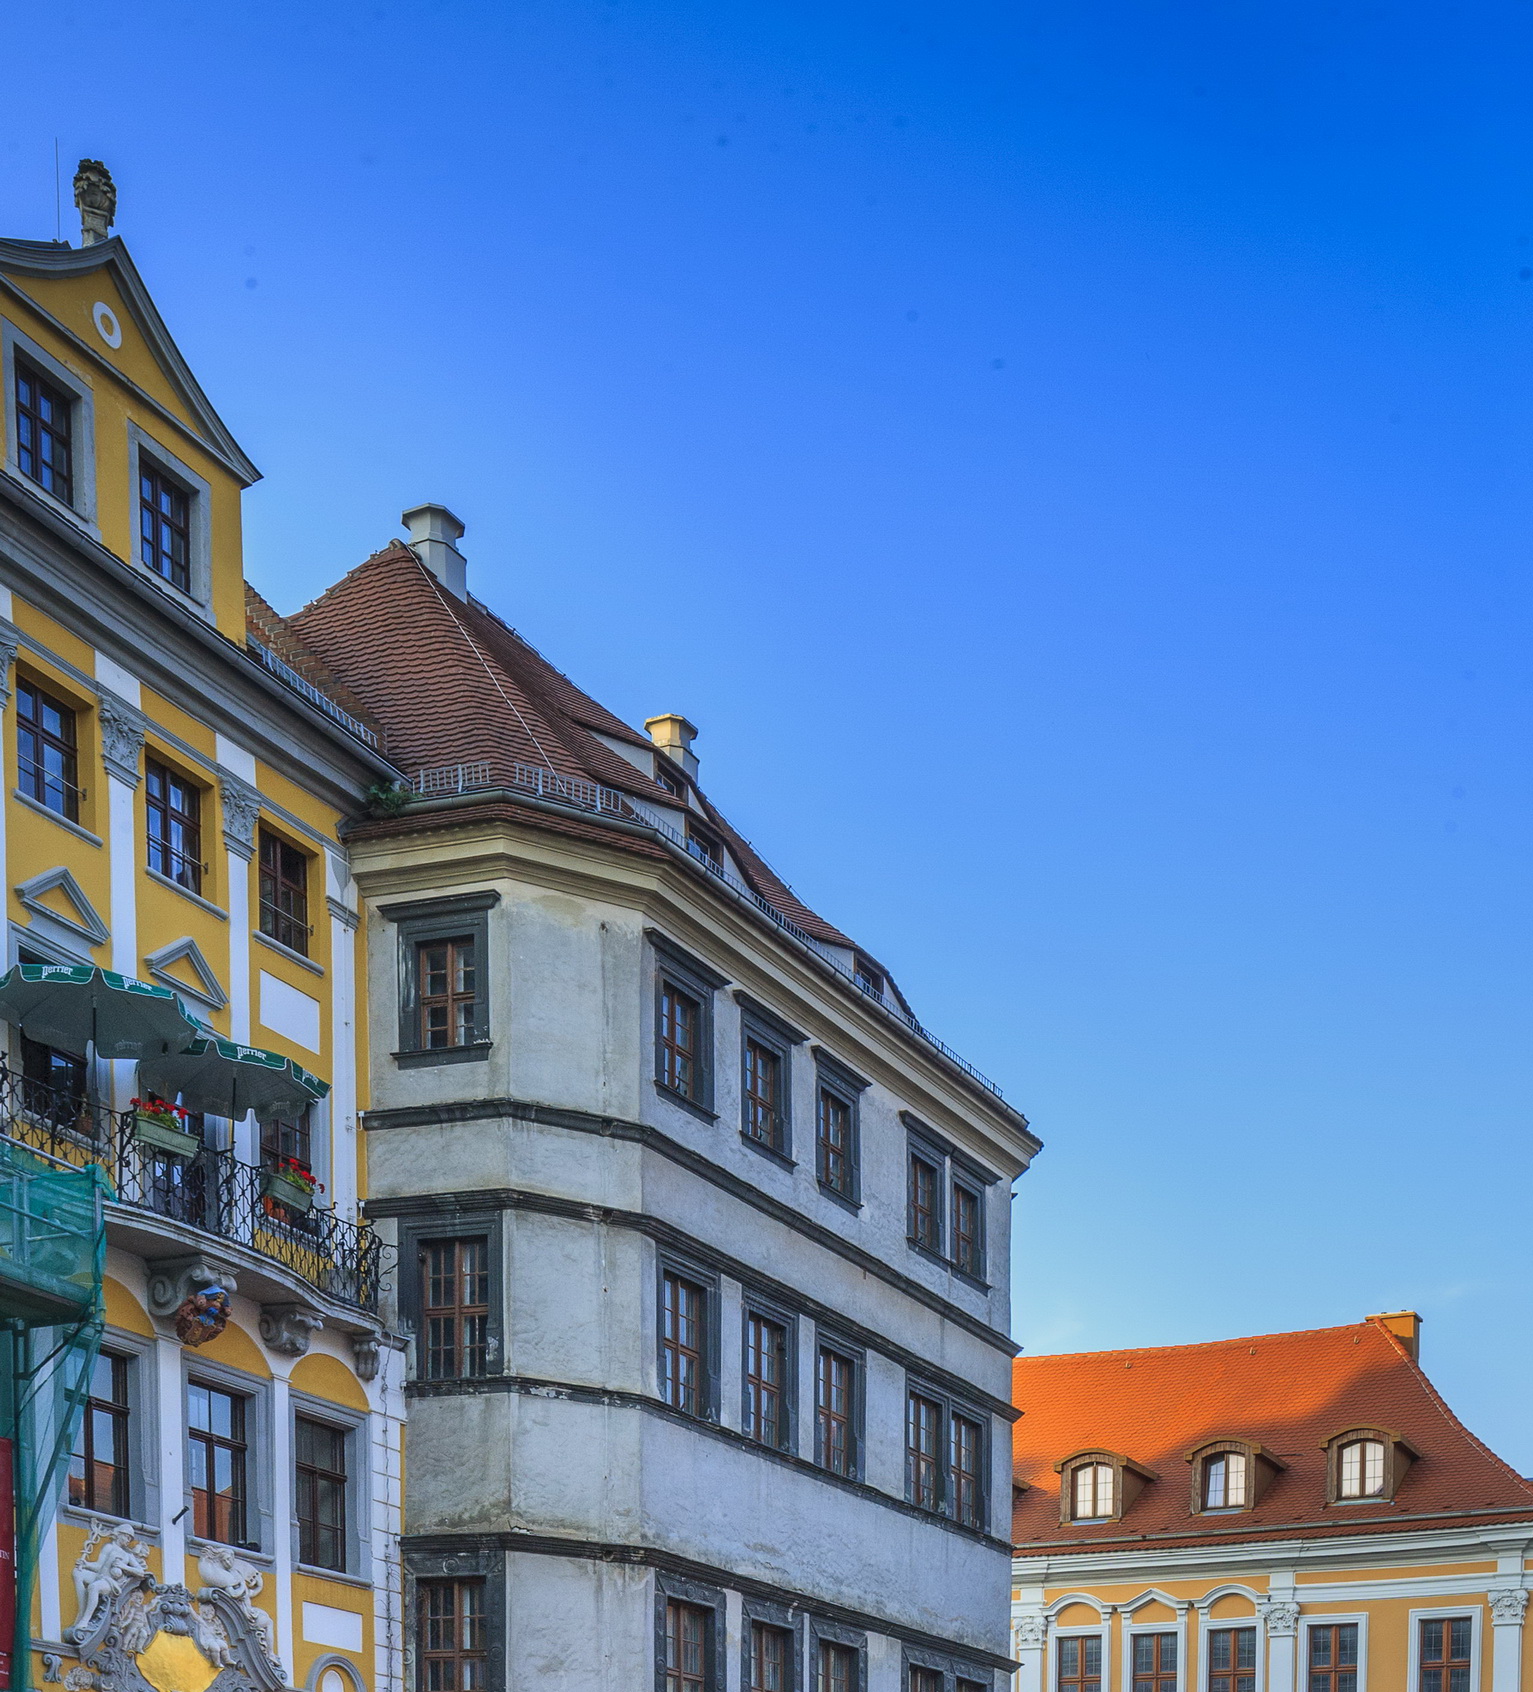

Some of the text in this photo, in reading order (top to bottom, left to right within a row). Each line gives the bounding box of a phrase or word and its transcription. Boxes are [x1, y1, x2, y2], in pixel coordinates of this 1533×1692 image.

[41, 965, 73, 979] perrier
[121, 976, 152, 990] perrier
[236, 1046, 267, 1060] perrier
